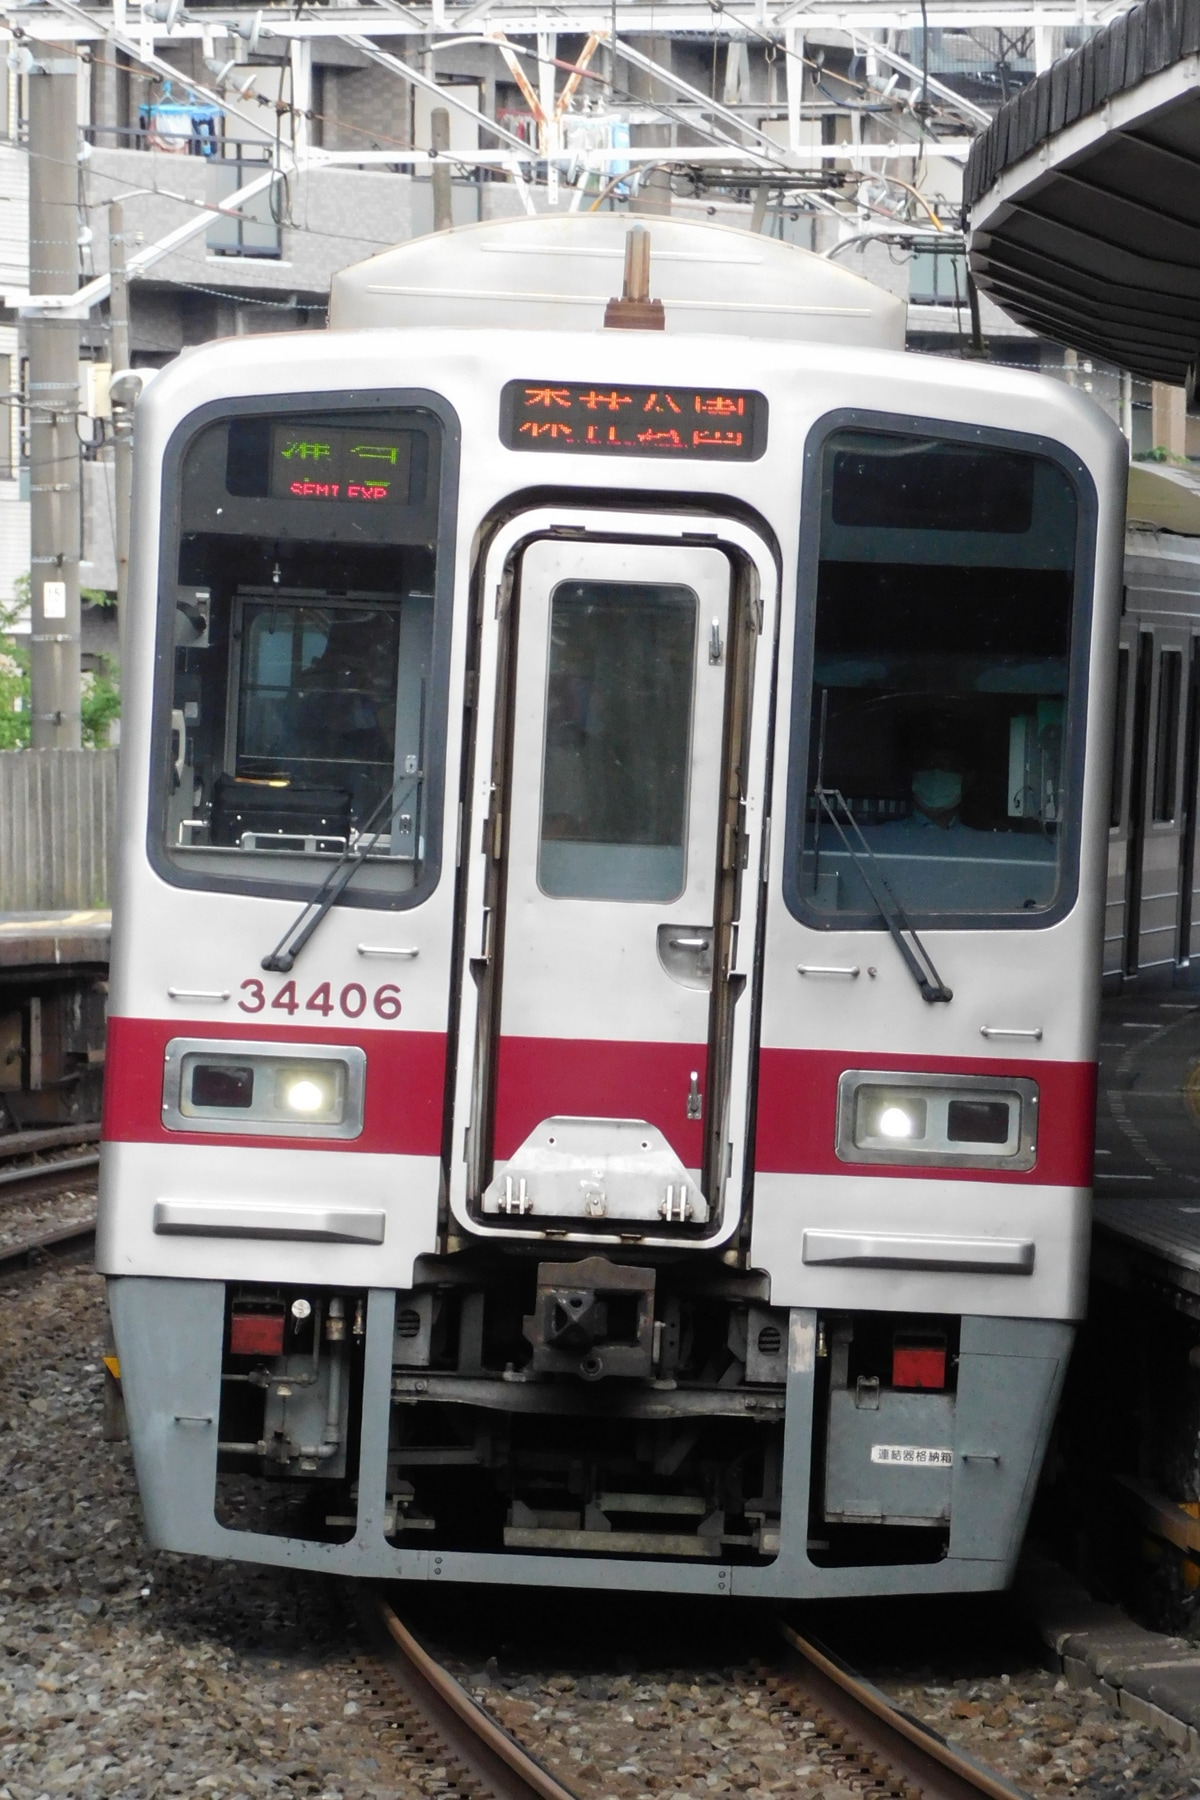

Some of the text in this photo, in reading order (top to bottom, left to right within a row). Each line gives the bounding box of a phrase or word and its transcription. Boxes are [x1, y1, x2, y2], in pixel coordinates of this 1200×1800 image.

[238, 978, 402, 1020] 34406
[878, 1447, 952, 1464] 連結器格納箱
